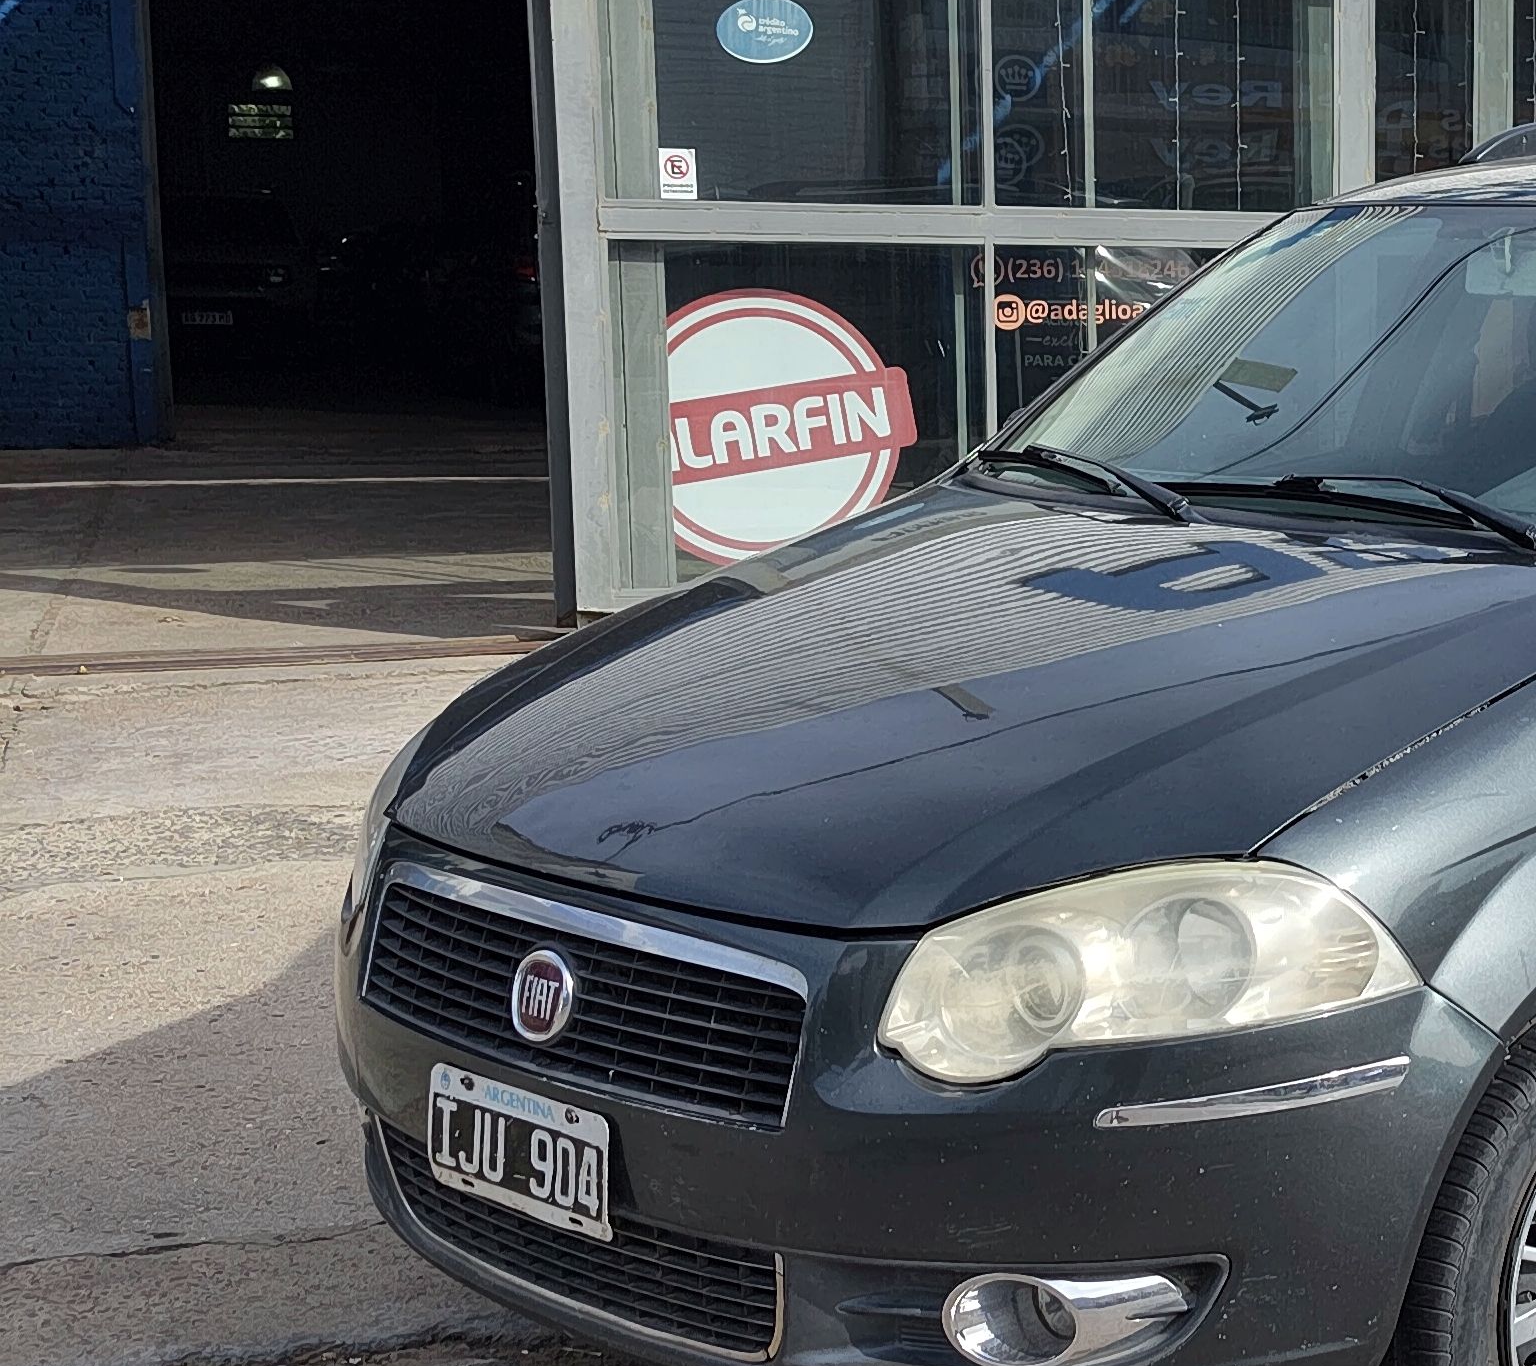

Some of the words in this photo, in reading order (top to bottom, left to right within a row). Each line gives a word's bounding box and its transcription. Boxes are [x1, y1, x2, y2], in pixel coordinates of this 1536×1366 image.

[758, 25, 799, 36] argentino
[1008, 258, 1063, 283] (236)
[1024, 354, 1064, 367] PARA
[521, 974, 560, 1021] FIAT
[484, 1084, 556, 1124] ARGENTINA
[434, 1098, 507, 1183] IJU
[529, 1128, 601, 1218] 904
